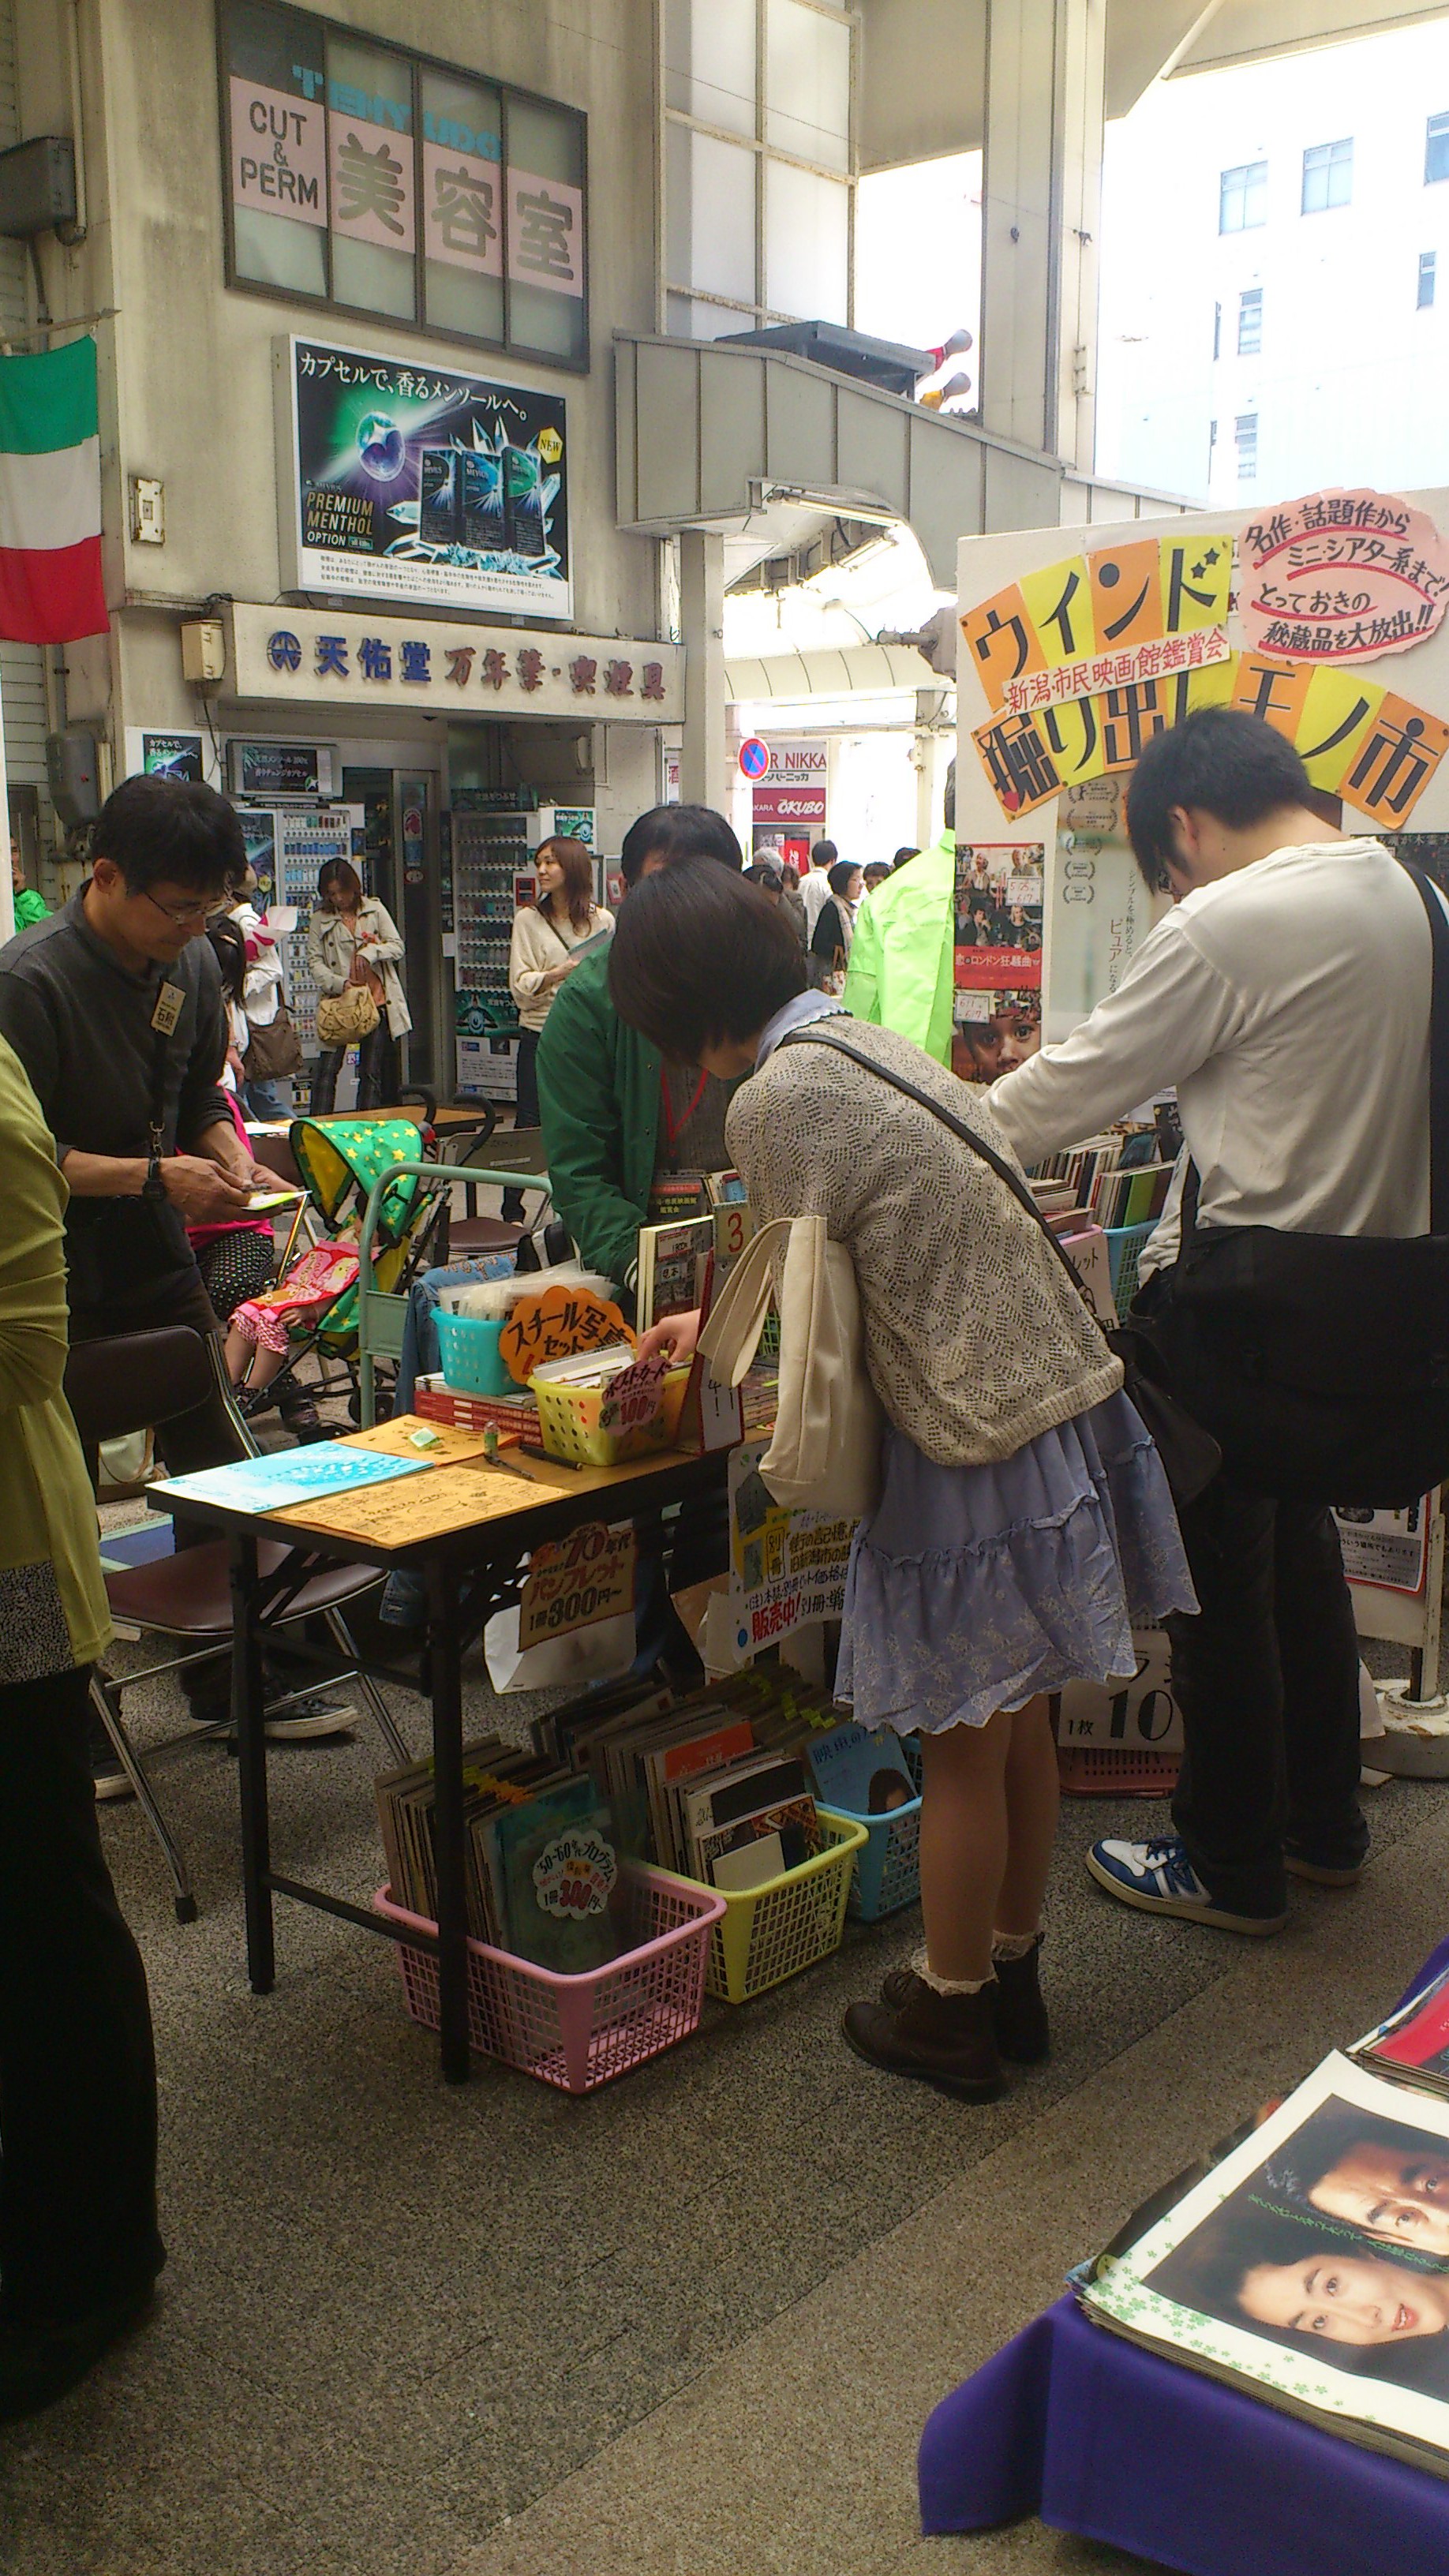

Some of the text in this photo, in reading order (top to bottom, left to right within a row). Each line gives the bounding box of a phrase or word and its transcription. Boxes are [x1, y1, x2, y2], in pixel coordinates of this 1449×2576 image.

[249, 100, 308, 147] CUT
[272, 140, 289, 168] &
[240, 157, 319, 210] PERM
[336, 133, 574, 281] 美容室
[540, 439, 561, 452] NEW
[306, 491, 375, 517] PREMIUM
[307, 509, 373, 535] MENTHOL
[307, 530, 346, 546] OPTION
[1259, 582, 1372, 615] とっておきの
[316, 635, 432, 683] 天佑堂
[785, 752, 826, 769] NIKKA
[1069, 1719, 1095, 1736] 1枚
